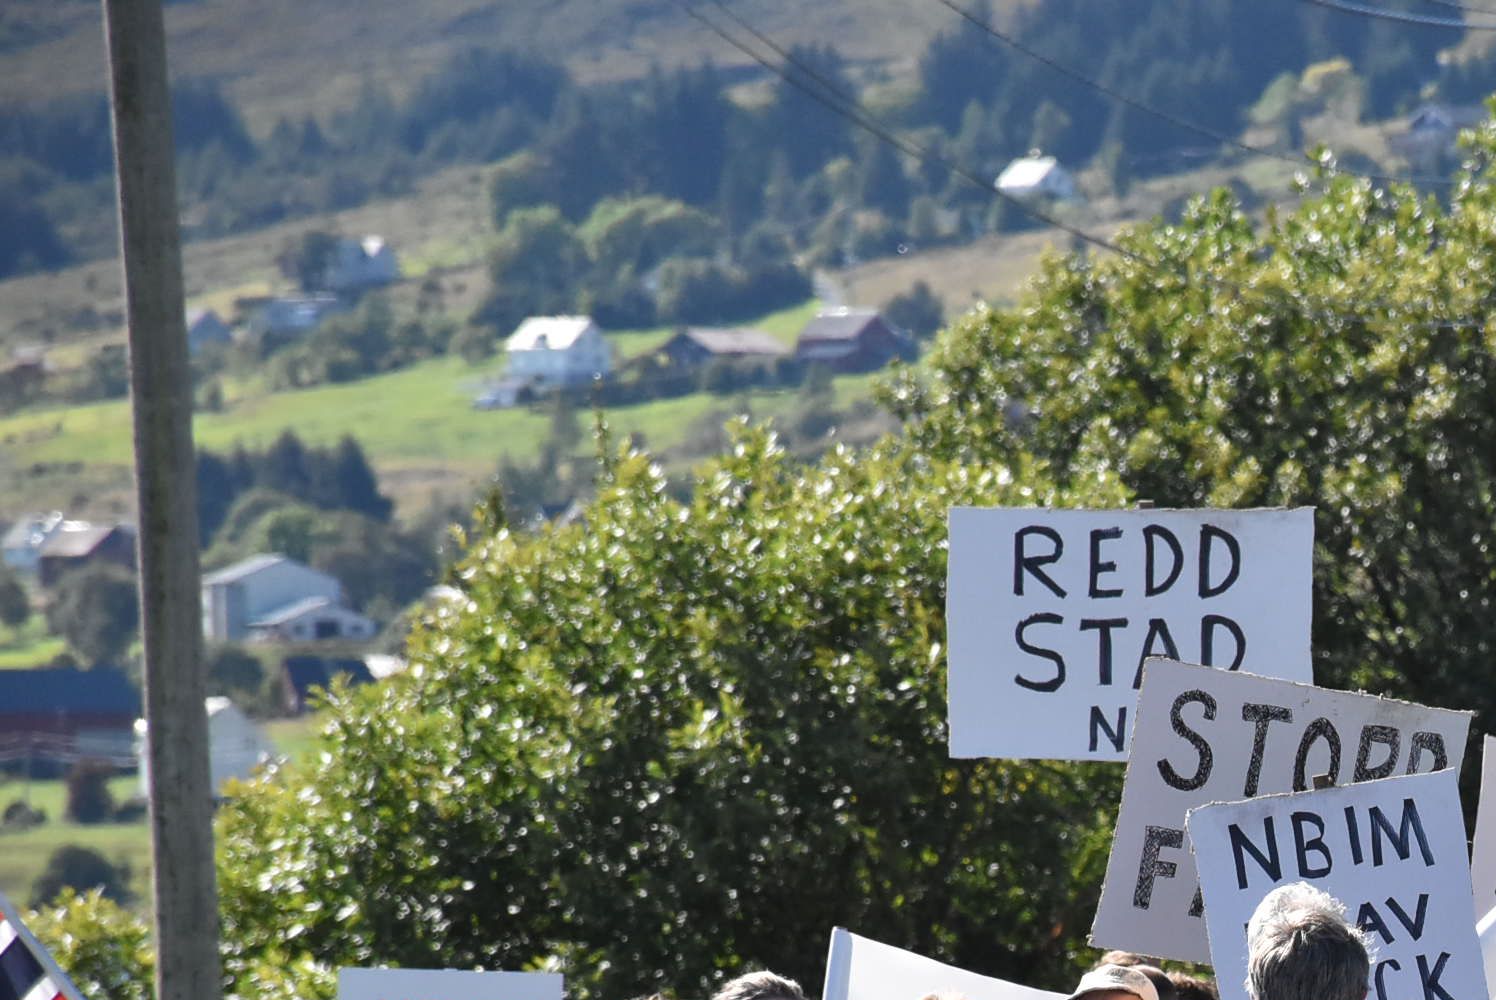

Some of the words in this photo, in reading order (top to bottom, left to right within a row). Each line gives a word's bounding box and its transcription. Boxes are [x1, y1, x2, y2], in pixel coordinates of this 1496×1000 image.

[1013, 524, 1241, 599] REDD
[1014, 613, 1247, 692] STAD
[1089, 706, 1127, 752] N
[1228, 798, 1435, 889] NBIM
